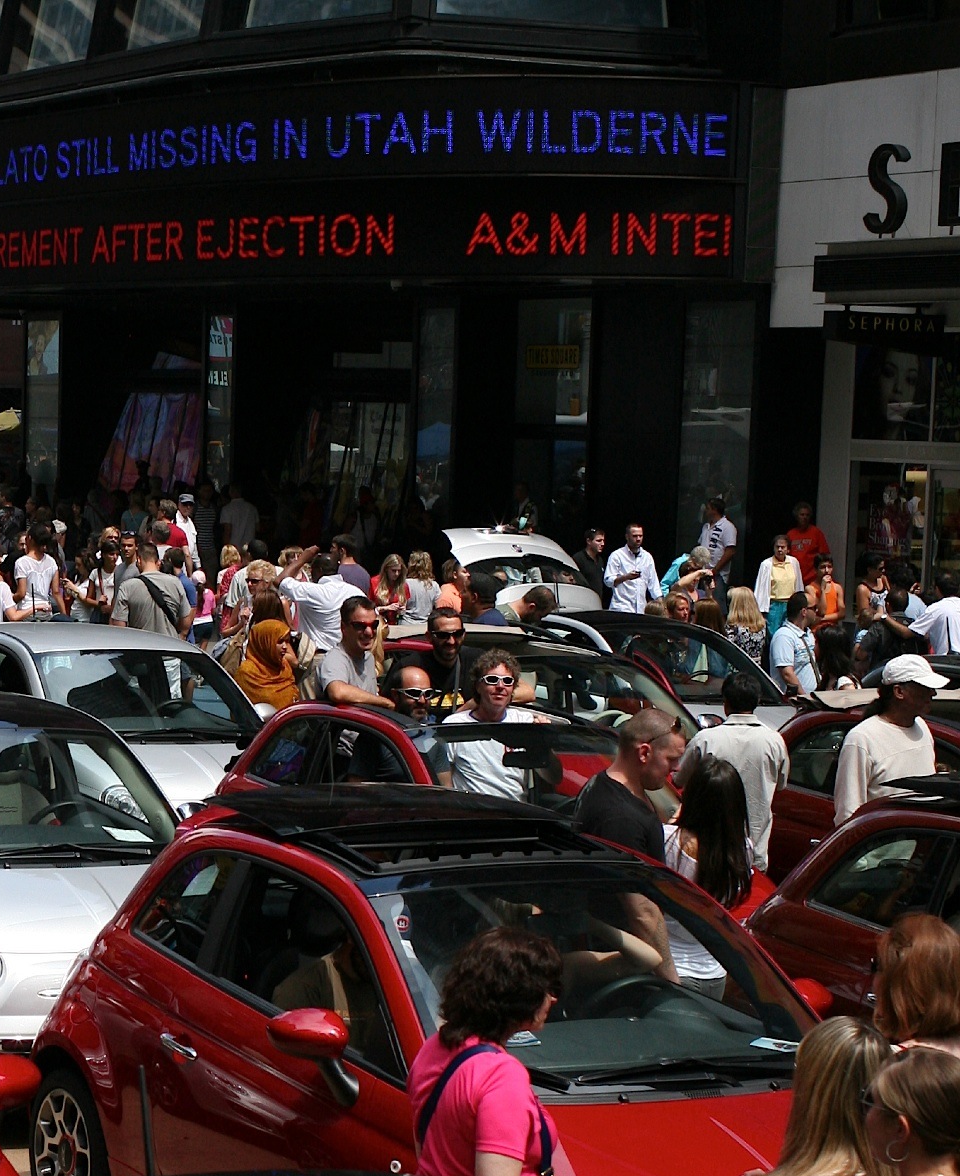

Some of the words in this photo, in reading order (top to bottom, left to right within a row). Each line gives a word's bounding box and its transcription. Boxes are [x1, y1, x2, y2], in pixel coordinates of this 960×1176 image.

[56, 136, 120, 179] STILL
[128, 120, 258, 171] MISSING
[272, 117, 309, 160] IN
[324, 110, 454, 159] UTAH
[477, 108, 729, 157] WILDERNE
[91, 218, 184, 264] AFTER
[196, 212, 397, 260] EJECTION
[464, 210, 590, 258] A&M
[848, 315, 935, 333] SEPHORA
[528, 348, 549, 364] TIMES
[550, 348, 578, 365] SQUARE
